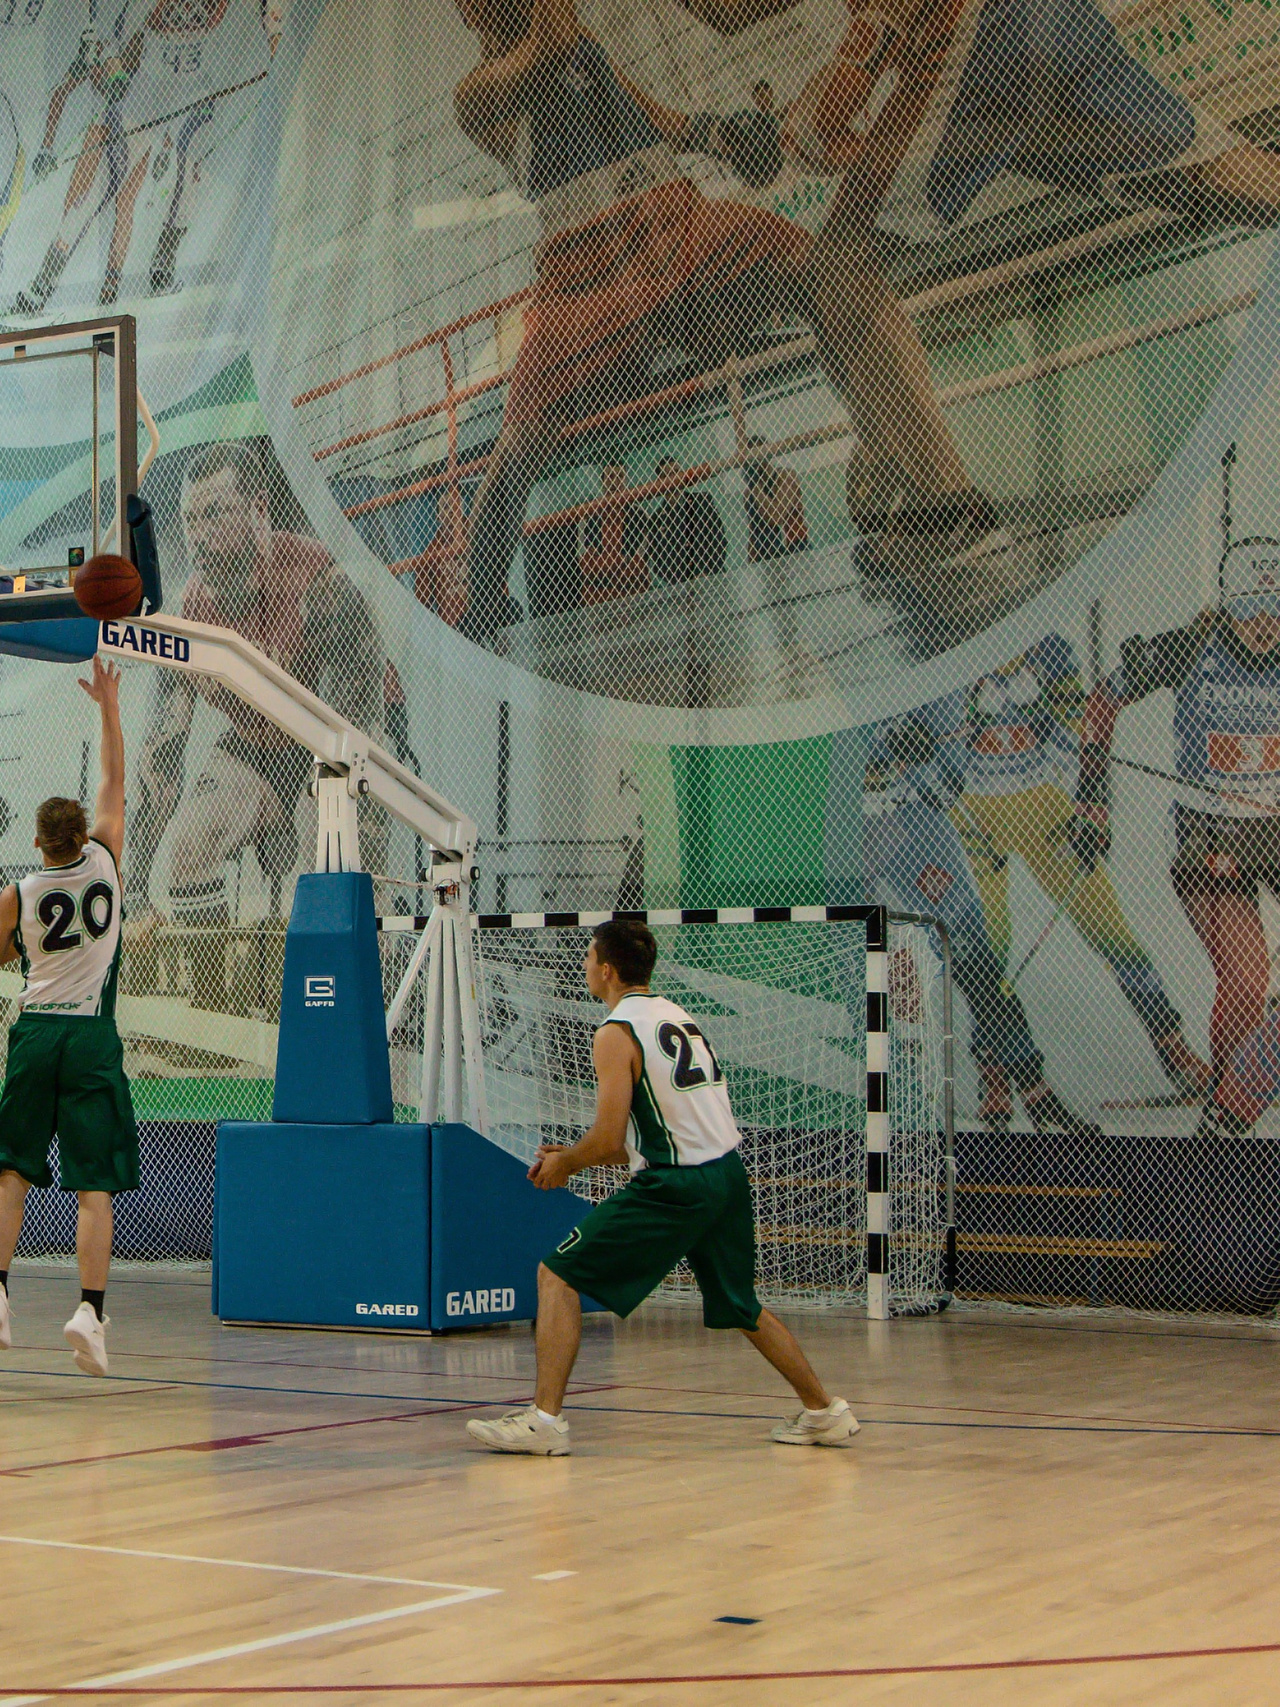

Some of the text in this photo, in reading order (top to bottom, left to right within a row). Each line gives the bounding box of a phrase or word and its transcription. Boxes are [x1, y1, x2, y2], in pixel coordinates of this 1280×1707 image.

[102, 620, 190, 662] GARED
[35, 879, 114, 954] 20
[355, 1303, 419, 1316] GARED
[446, 1288, 515, 1317] GARED
